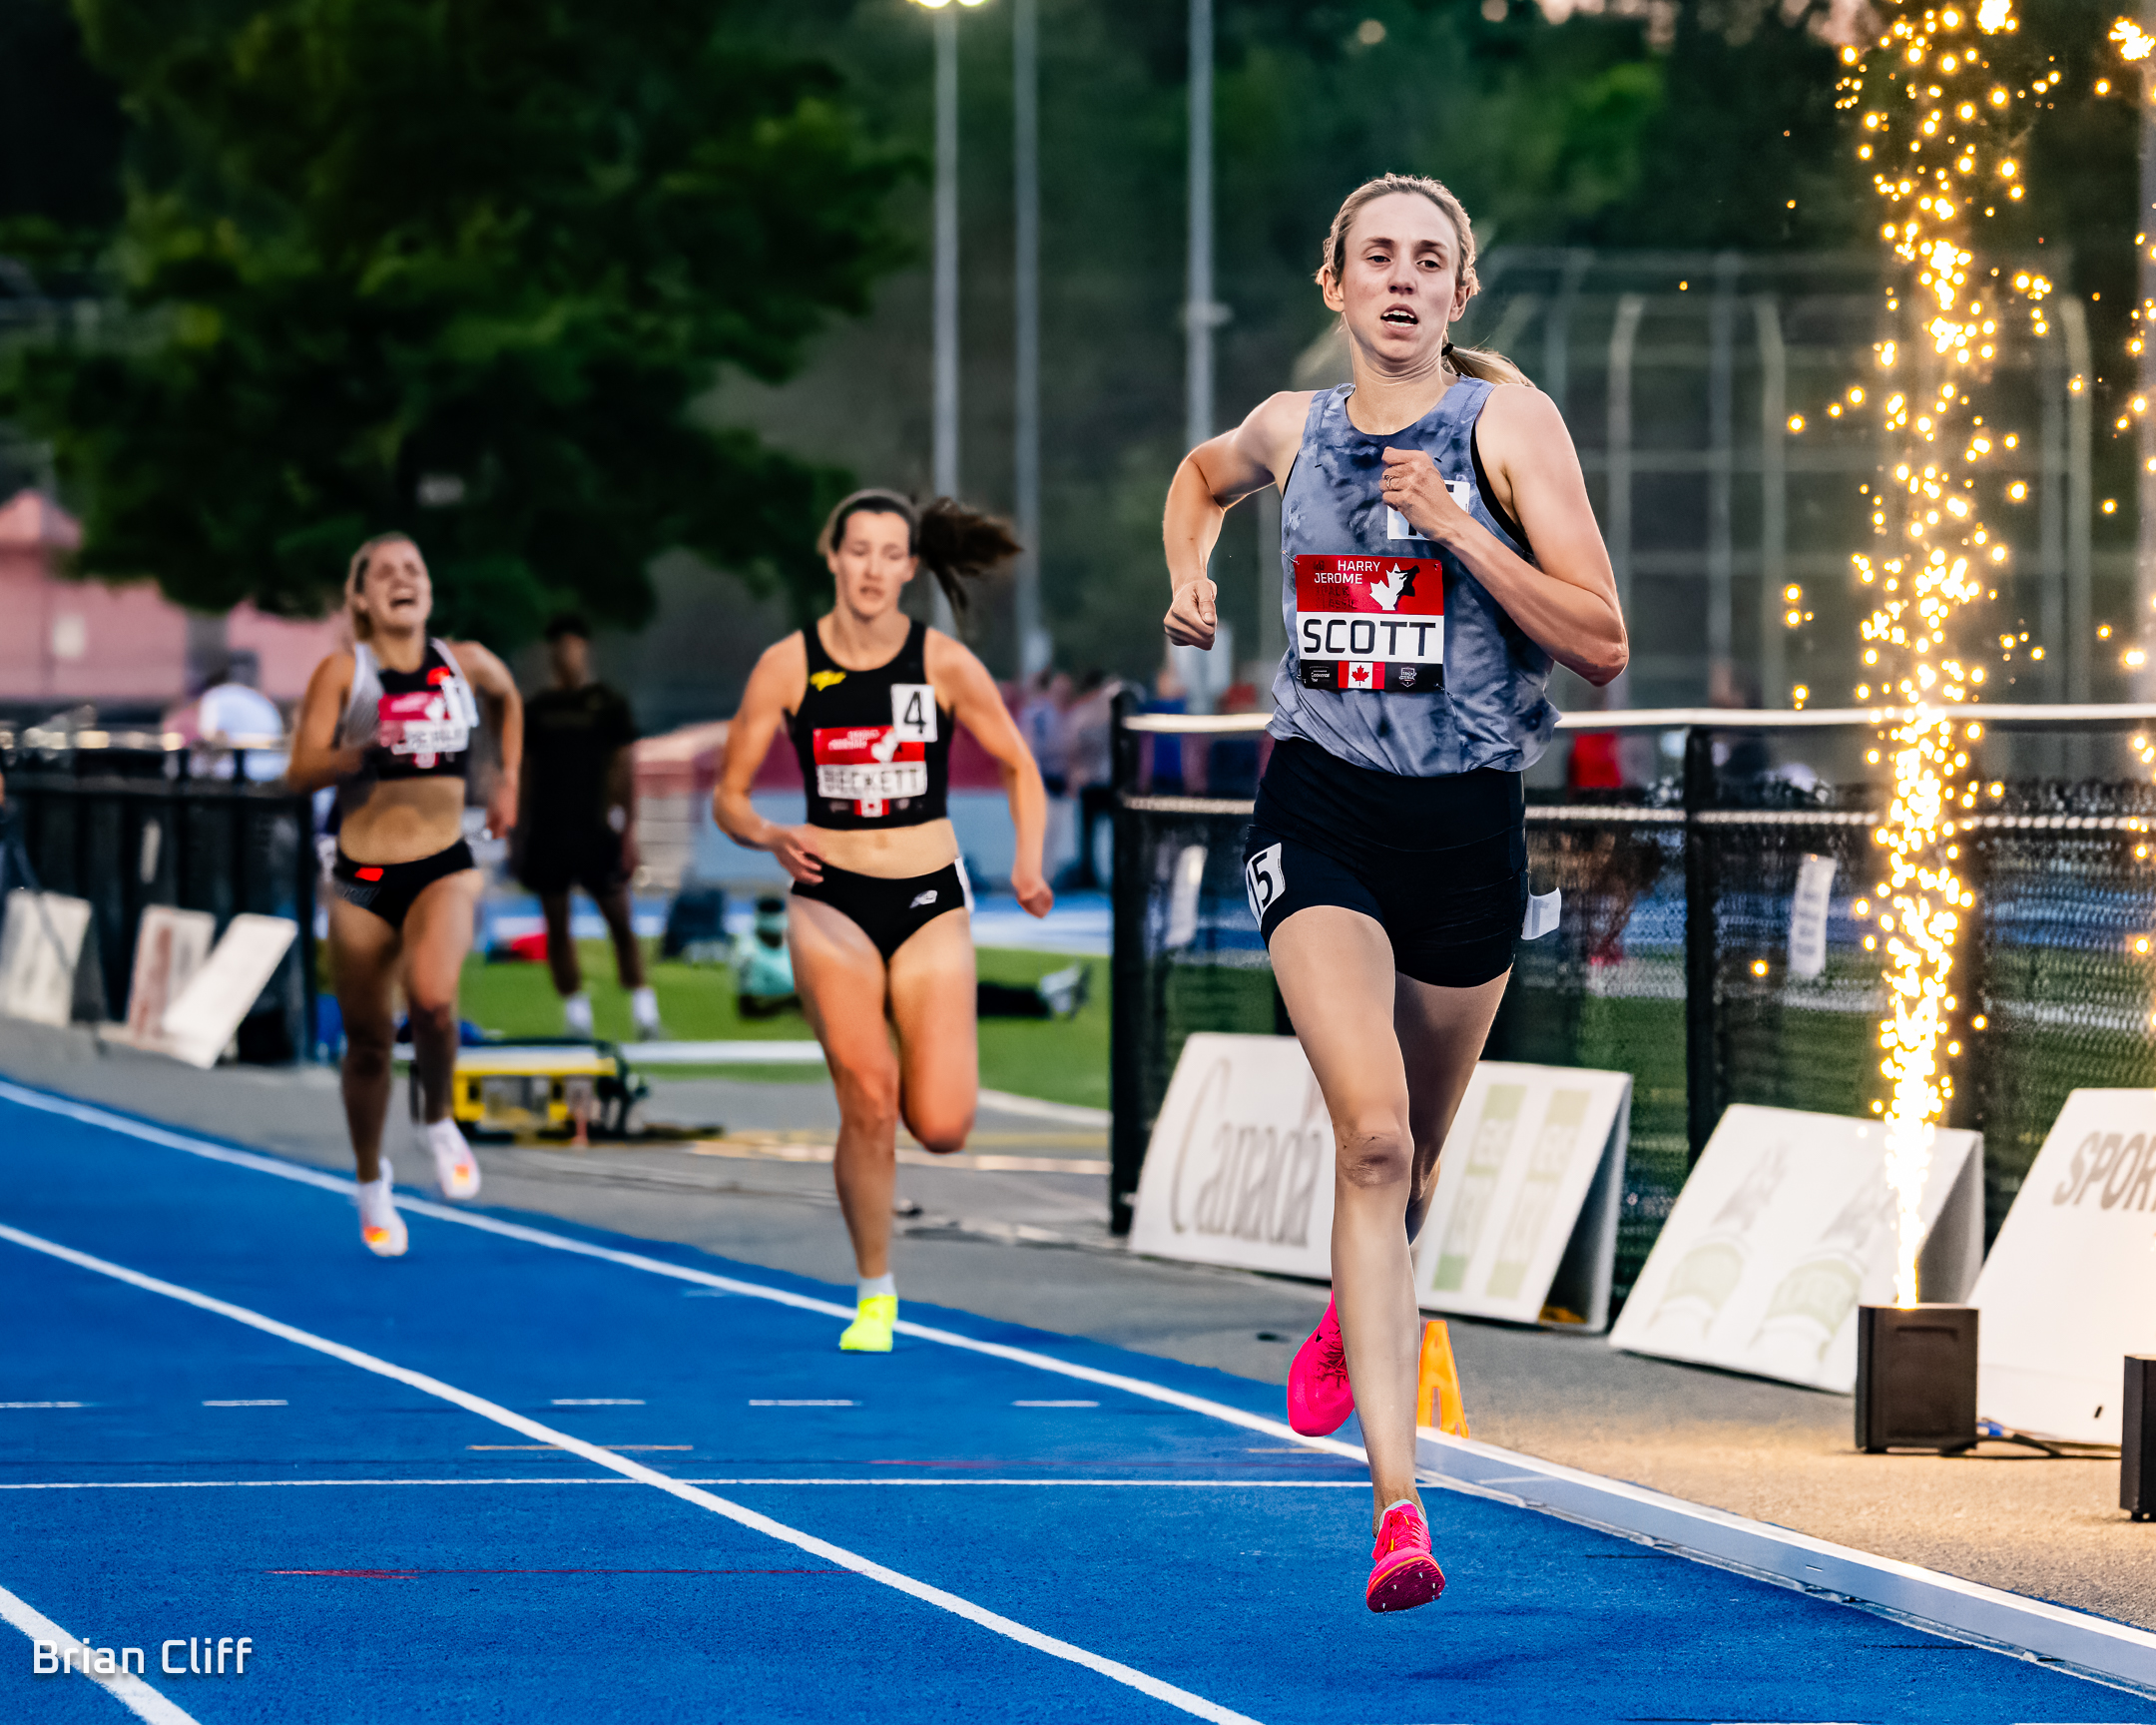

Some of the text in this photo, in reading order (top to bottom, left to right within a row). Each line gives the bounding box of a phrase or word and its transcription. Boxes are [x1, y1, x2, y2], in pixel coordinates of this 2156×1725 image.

[1314, 572, 1363, 585] JEROME
[1338, 560, 1381, 572] HARRY
[1304, 619, 1435, 656] SCOTT
[903, 691, 926, 734] 4
[1247, 851, 1274, 917] 15
[1170, 1058, 1321, 1248] Canada
[2054, 1132, 2156, 1210] SPOR
